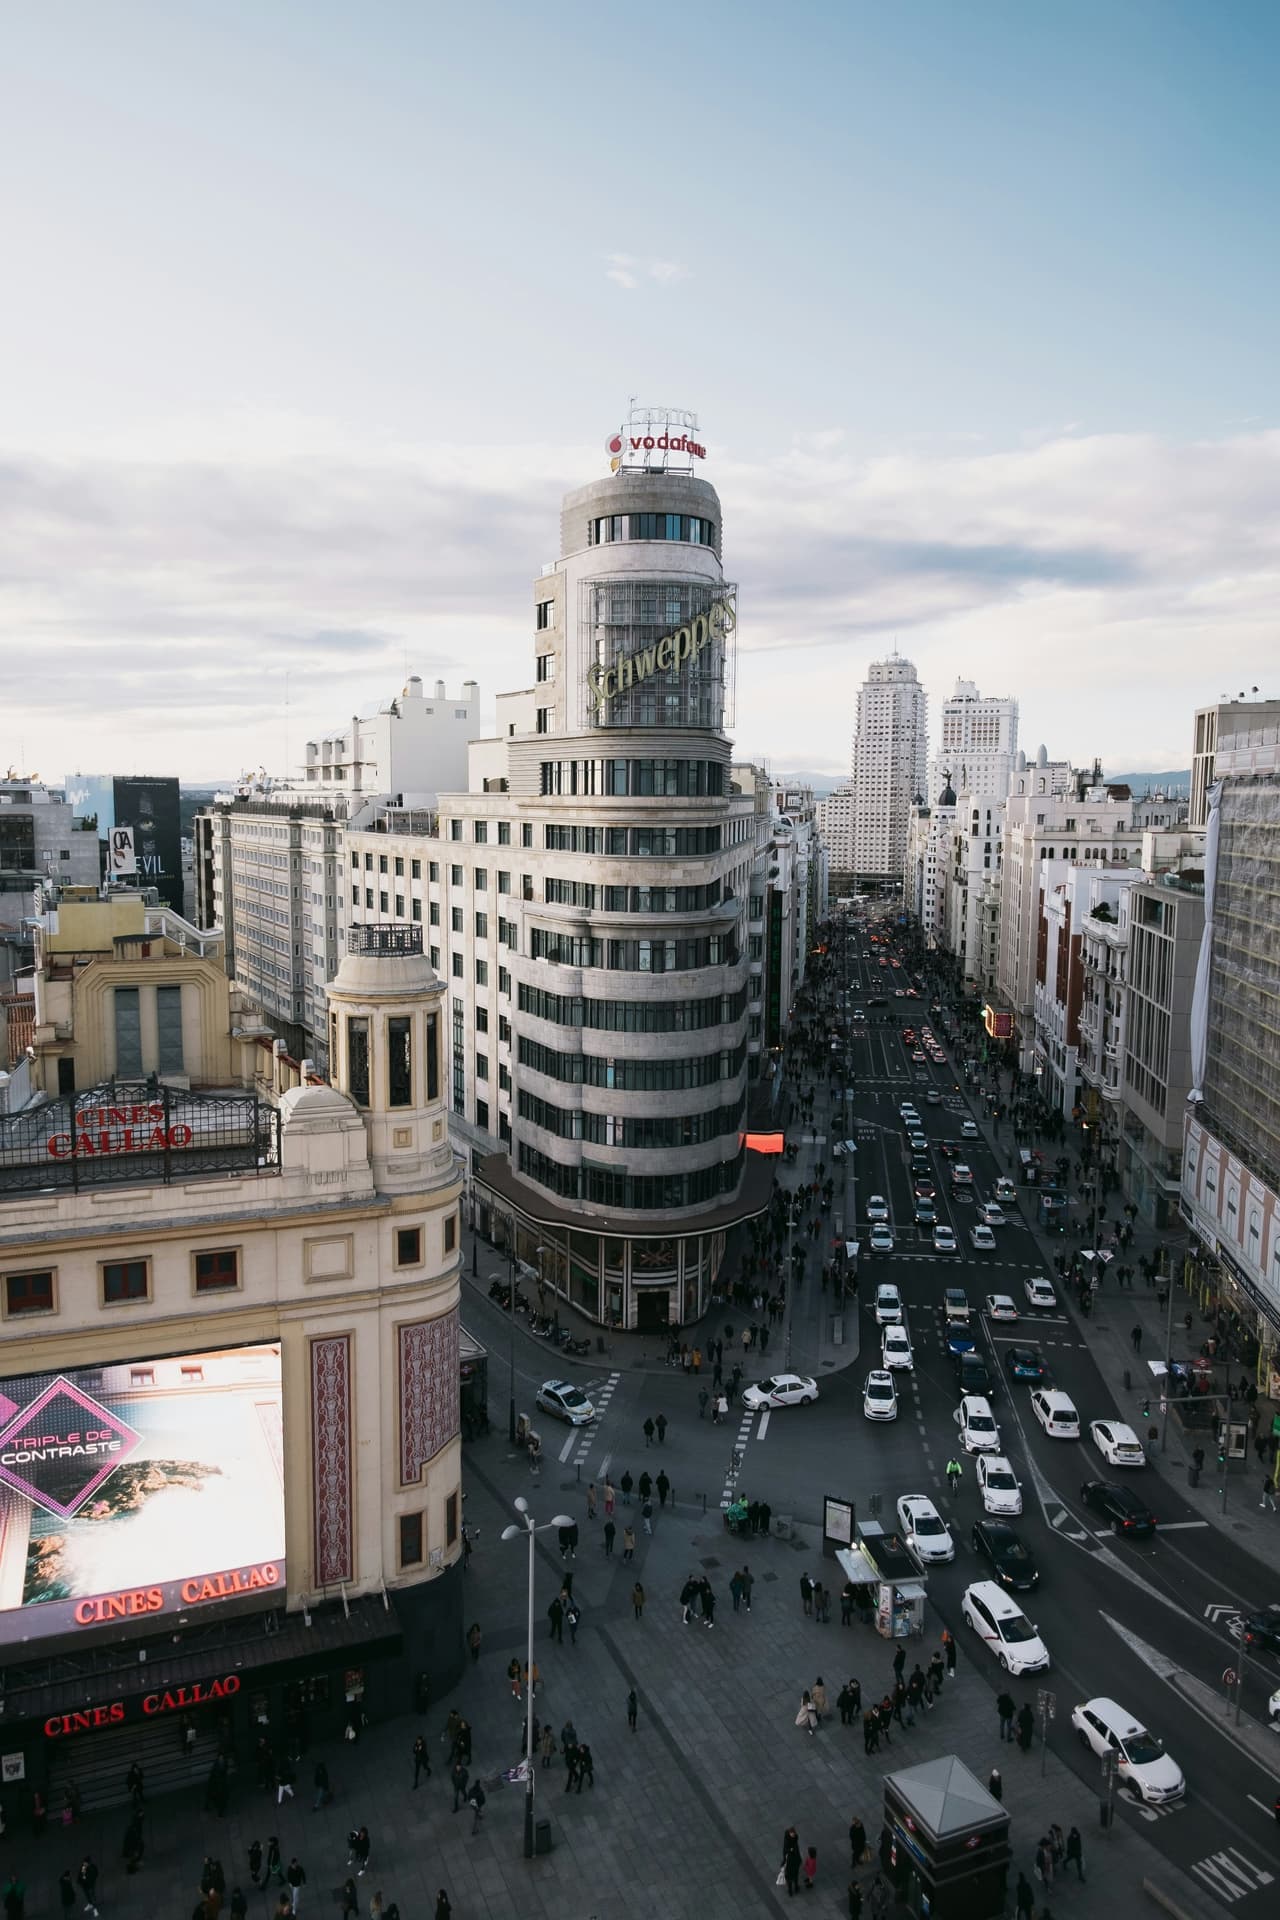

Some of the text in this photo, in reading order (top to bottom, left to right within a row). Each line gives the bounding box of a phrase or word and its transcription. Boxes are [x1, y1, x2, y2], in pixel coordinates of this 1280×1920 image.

[630, 432, 706, 459] vodafone
[587, 592, 736, 714] Schweppes
[76, 1103, 164, 1128] CINES
[48, 1123, 192, 1157] CALLAO
[1, 1440, 121, 1465] CONTRASTE
[10, 1429, 113, 1449] TRIPLE DE
[75, 1563, 279, 1624] CINES CALLAO
[44, 1675, 241, 1737] CINES CALLAO
[1191, 1846, 1275, 1903] TAXI
